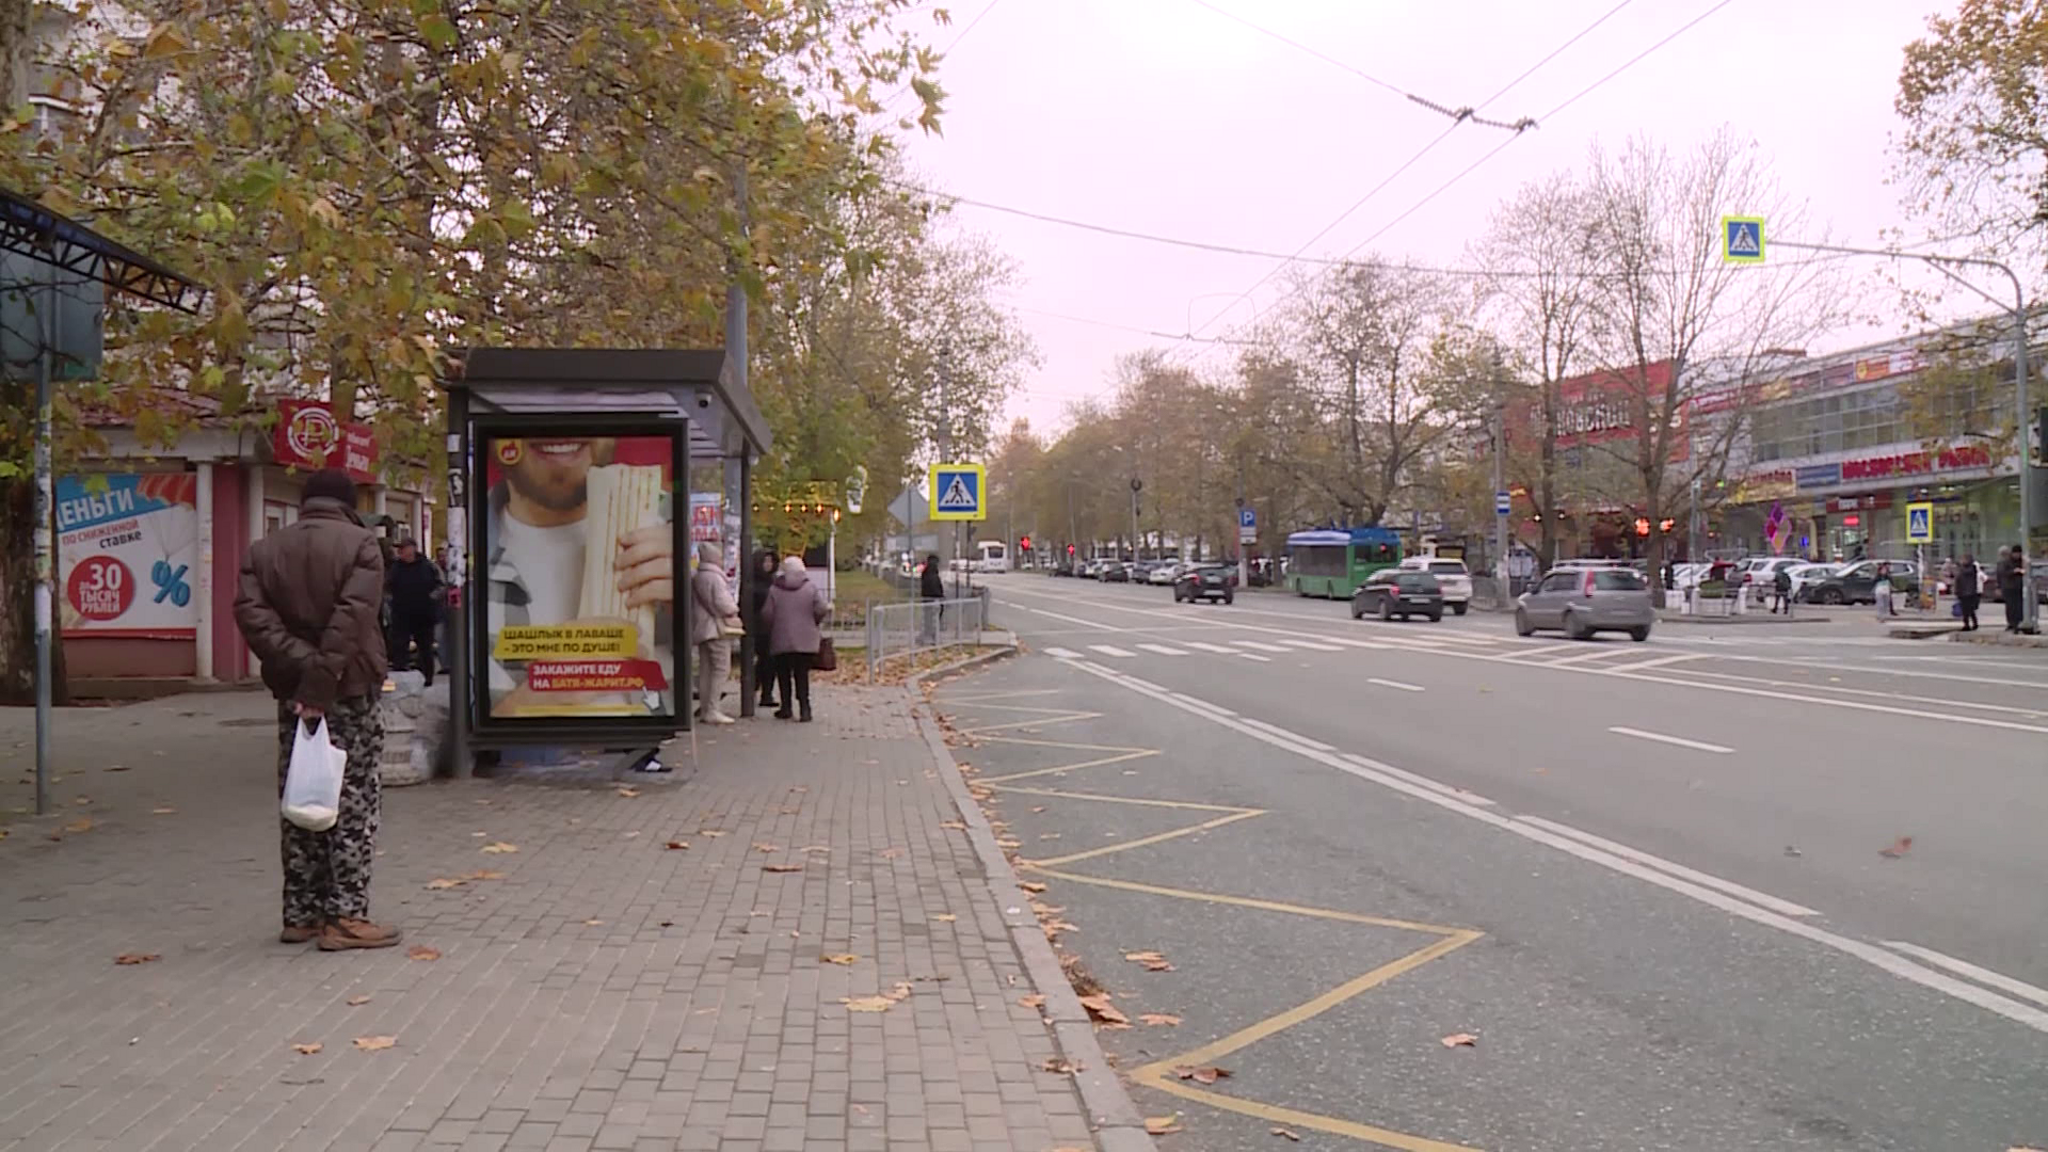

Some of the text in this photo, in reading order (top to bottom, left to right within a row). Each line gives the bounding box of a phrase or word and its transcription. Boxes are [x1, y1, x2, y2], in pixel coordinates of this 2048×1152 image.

[62, 519, 140, 547] ПО СНИЖЕННОЙ
[100, 531, 142, 549] ставке
[89, 563, 122, 591] 30
[79, 589, 120, 603] ТЫСЯЧ
[80, 602, 120, 613] РУБЛЕЙ
[504, 629, 624, 640] ШАШЛЫК В ЛАВАШЕ
[511, 643, 534, 653] ЭТО
[536, 643, 561, 653] МНЕ
[563, 643, 580, 653] ПО
[582, 643, 620, 653] ДУШЕ!
[533, 664, 621, 675] ЗАКАЖИТЕ ЕДУ
[533, 677, 644, 689] НА БАТЯ-ЖАРИТ.РФ
